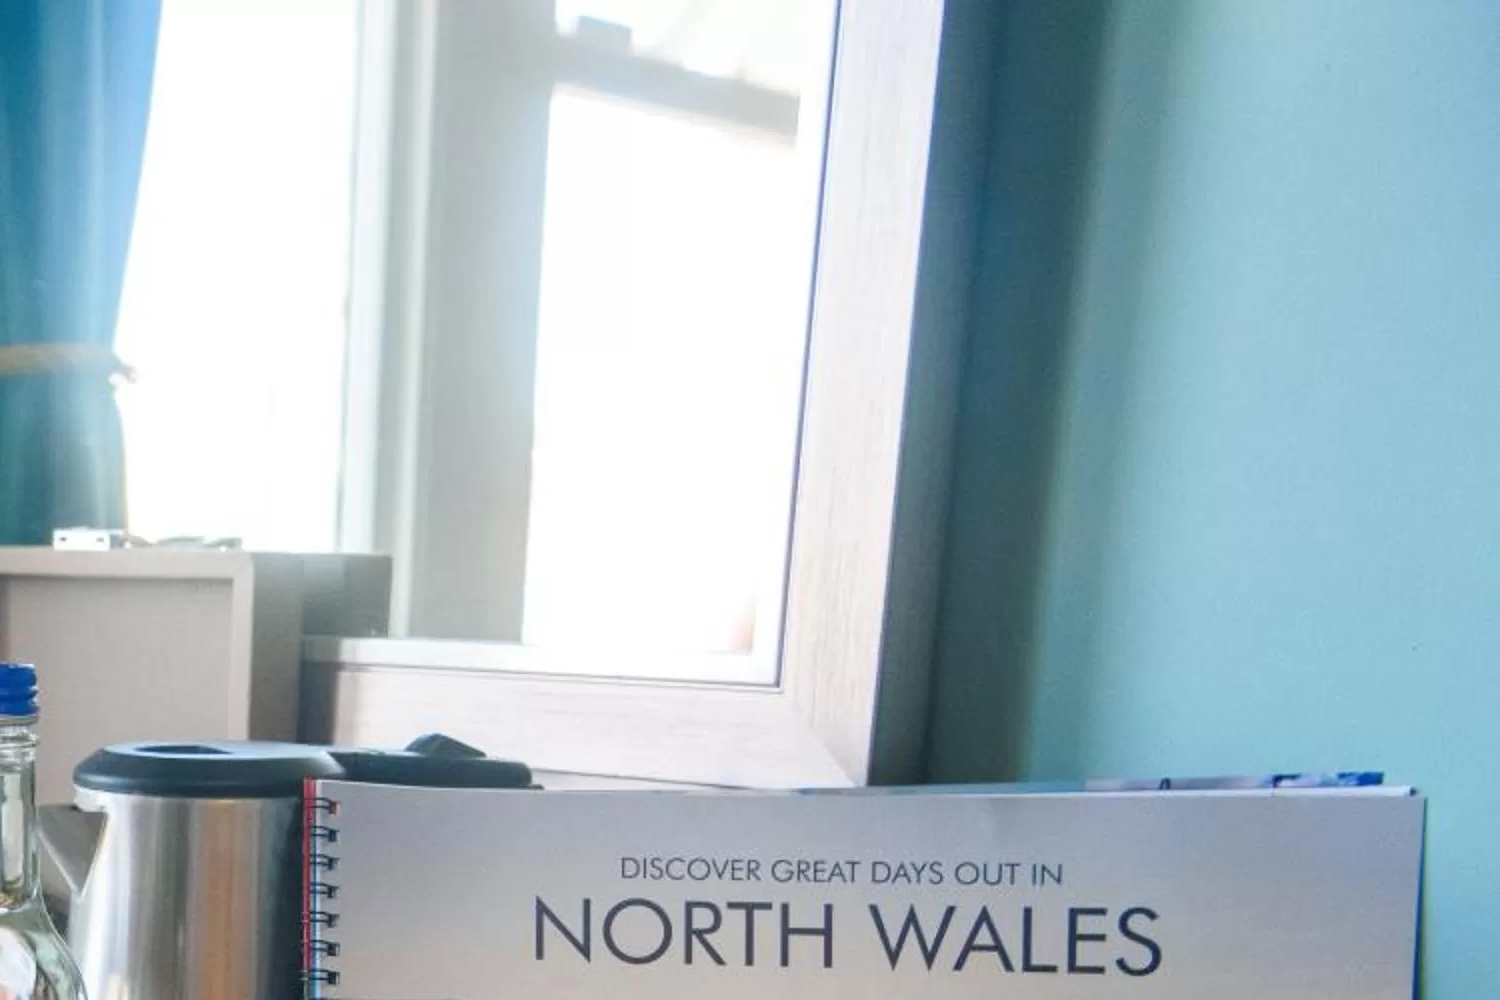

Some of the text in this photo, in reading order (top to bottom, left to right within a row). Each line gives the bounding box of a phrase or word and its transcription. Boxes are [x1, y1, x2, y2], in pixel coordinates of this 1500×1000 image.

[620, 856, 1063, 888] DISCOVER GREAT DAYS OUT IN
[534, 895, 1163, 977] NORTH WALES
